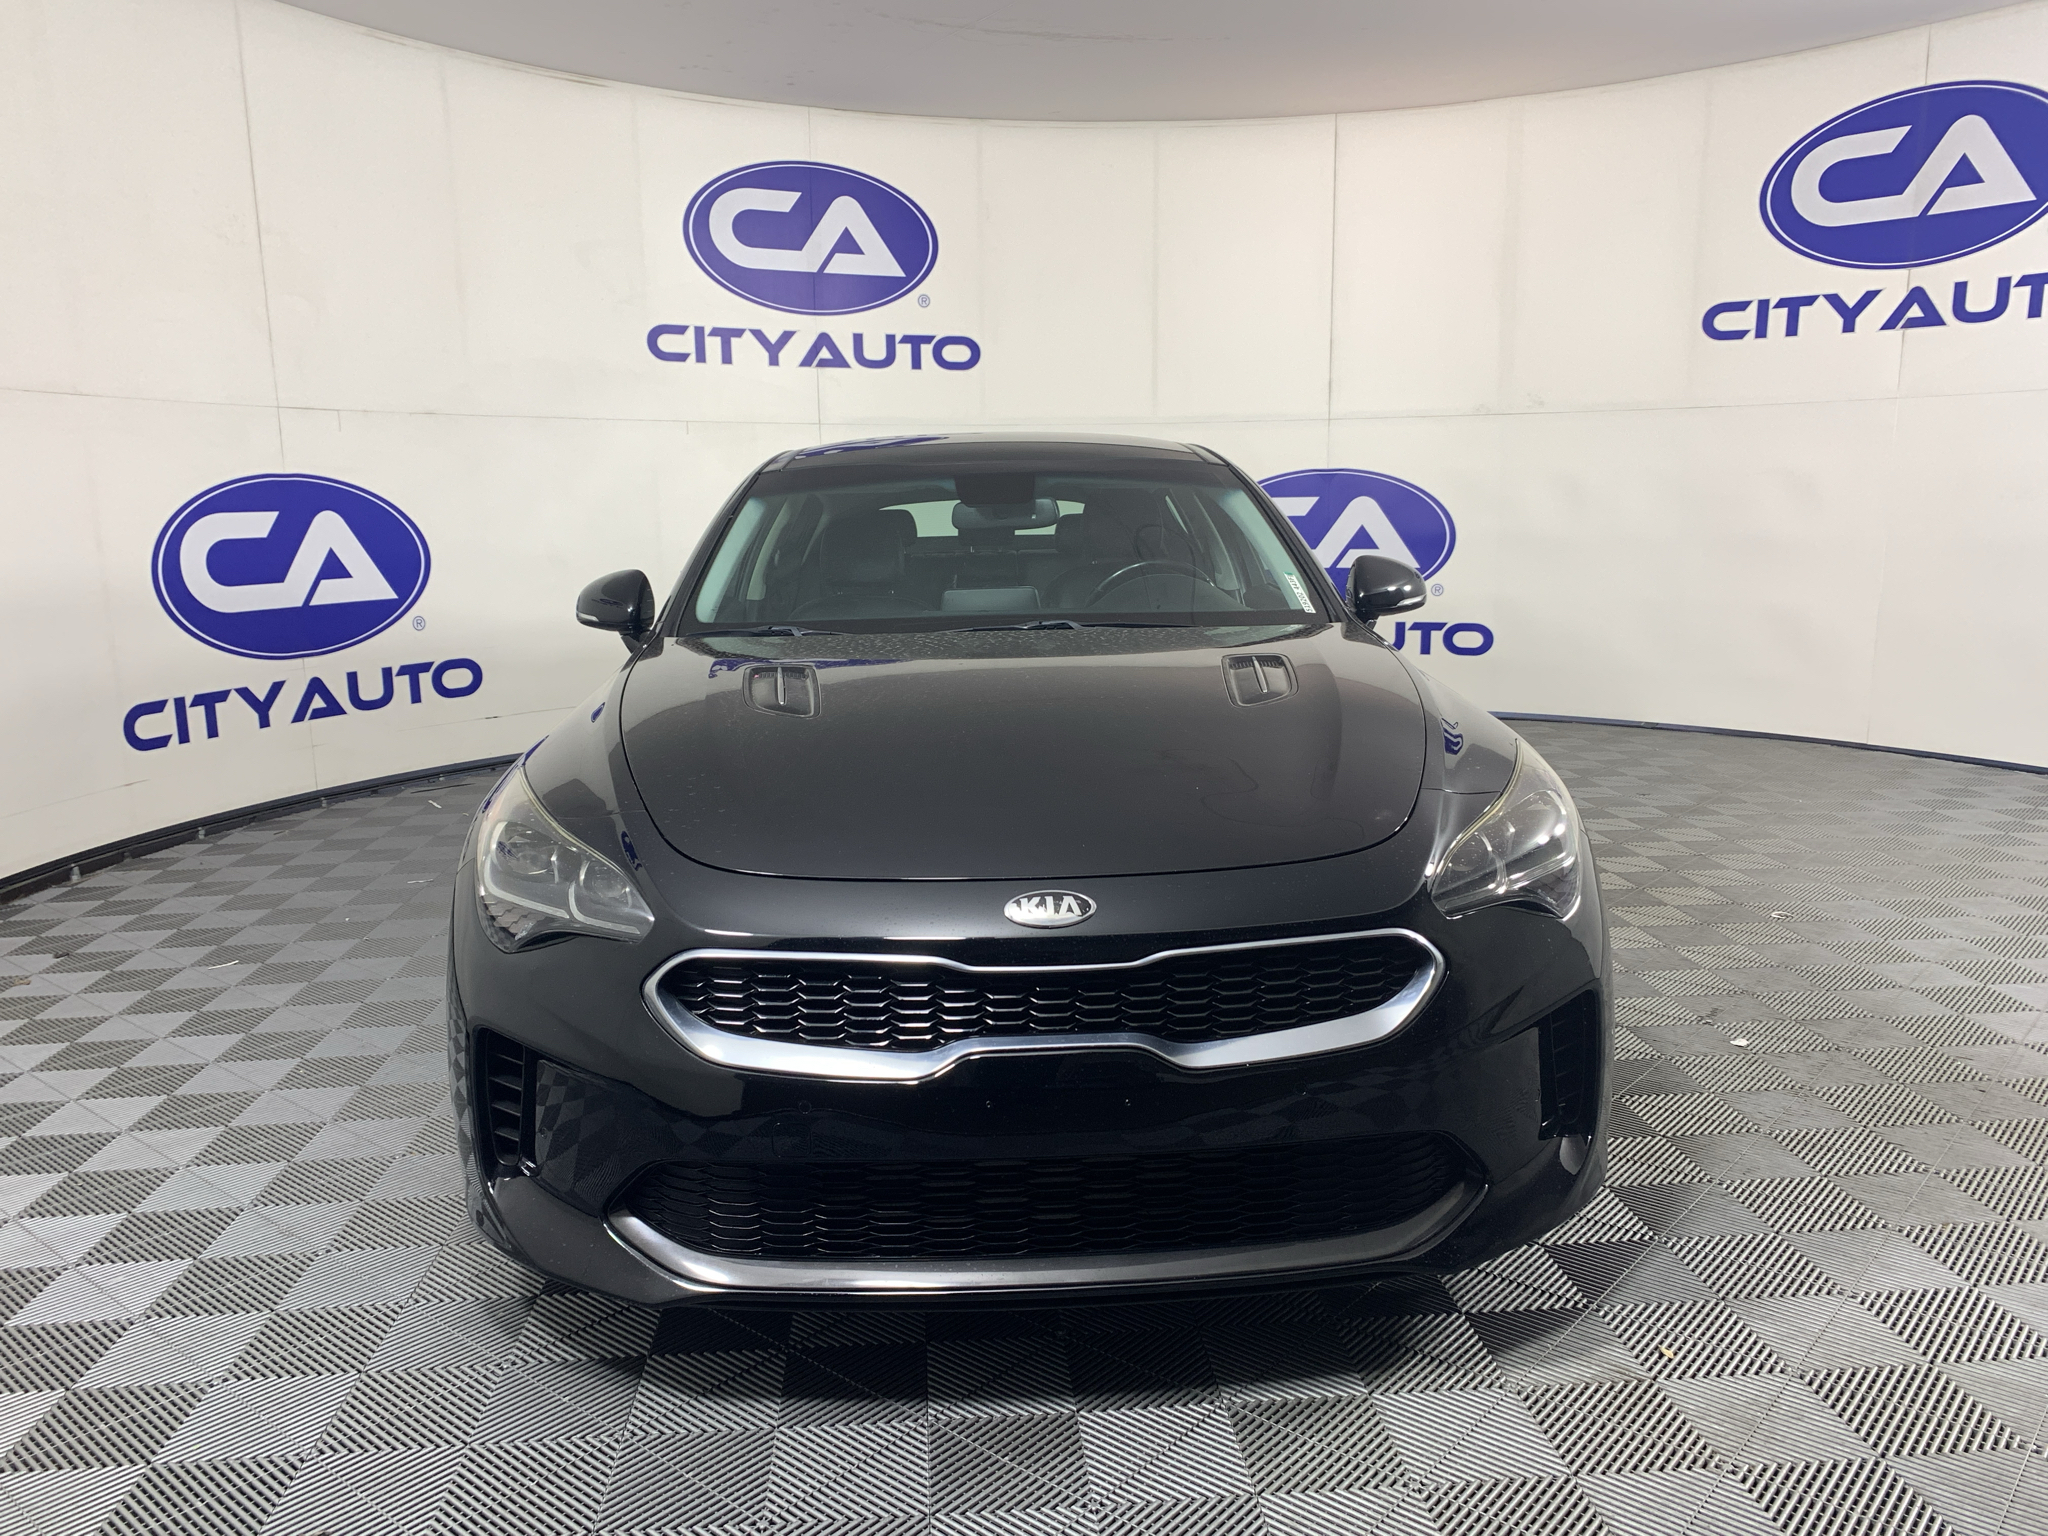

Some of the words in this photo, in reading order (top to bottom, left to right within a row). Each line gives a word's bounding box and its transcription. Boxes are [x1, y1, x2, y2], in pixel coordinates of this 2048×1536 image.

[1791, 114, 2037, 227] CA
[709, 187, 906, 277] CA
[179, 510, 398, 613] CA
[1019, 895, 1082, 917] KIA
